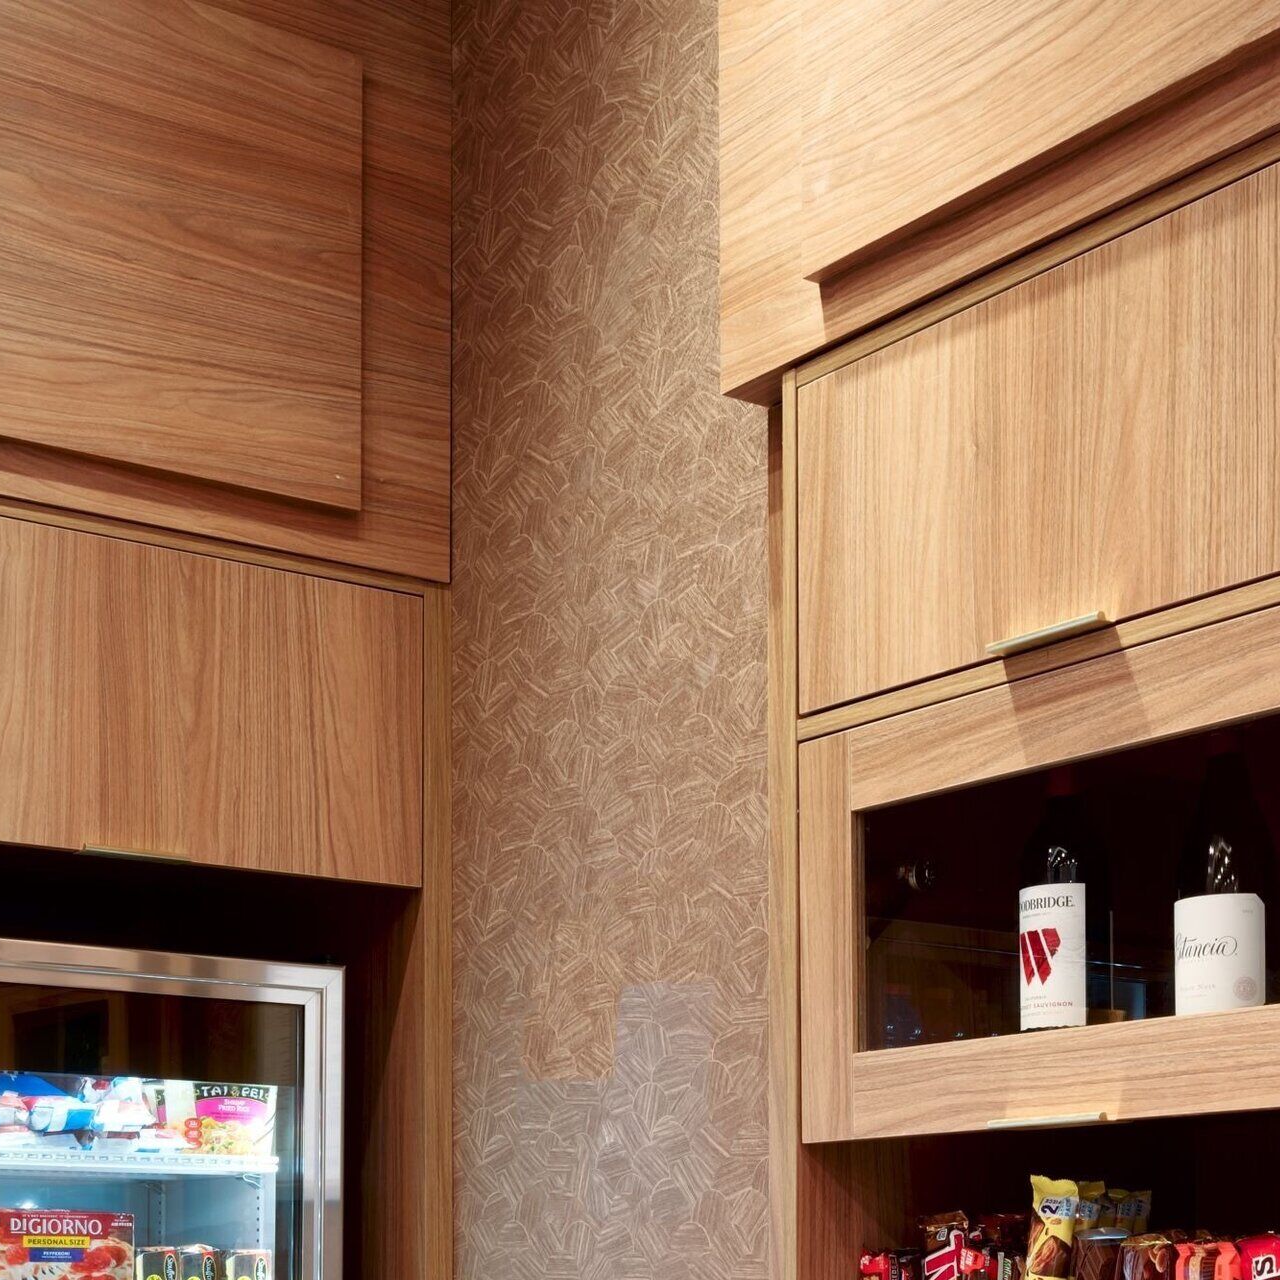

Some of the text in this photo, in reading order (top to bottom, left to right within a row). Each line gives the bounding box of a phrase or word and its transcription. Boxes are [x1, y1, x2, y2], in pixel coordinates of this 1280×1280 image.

[10, 1217, 104, 1236] DIGIORNO
[27, 1237, 86, 1247] PERSONAL SIZE
